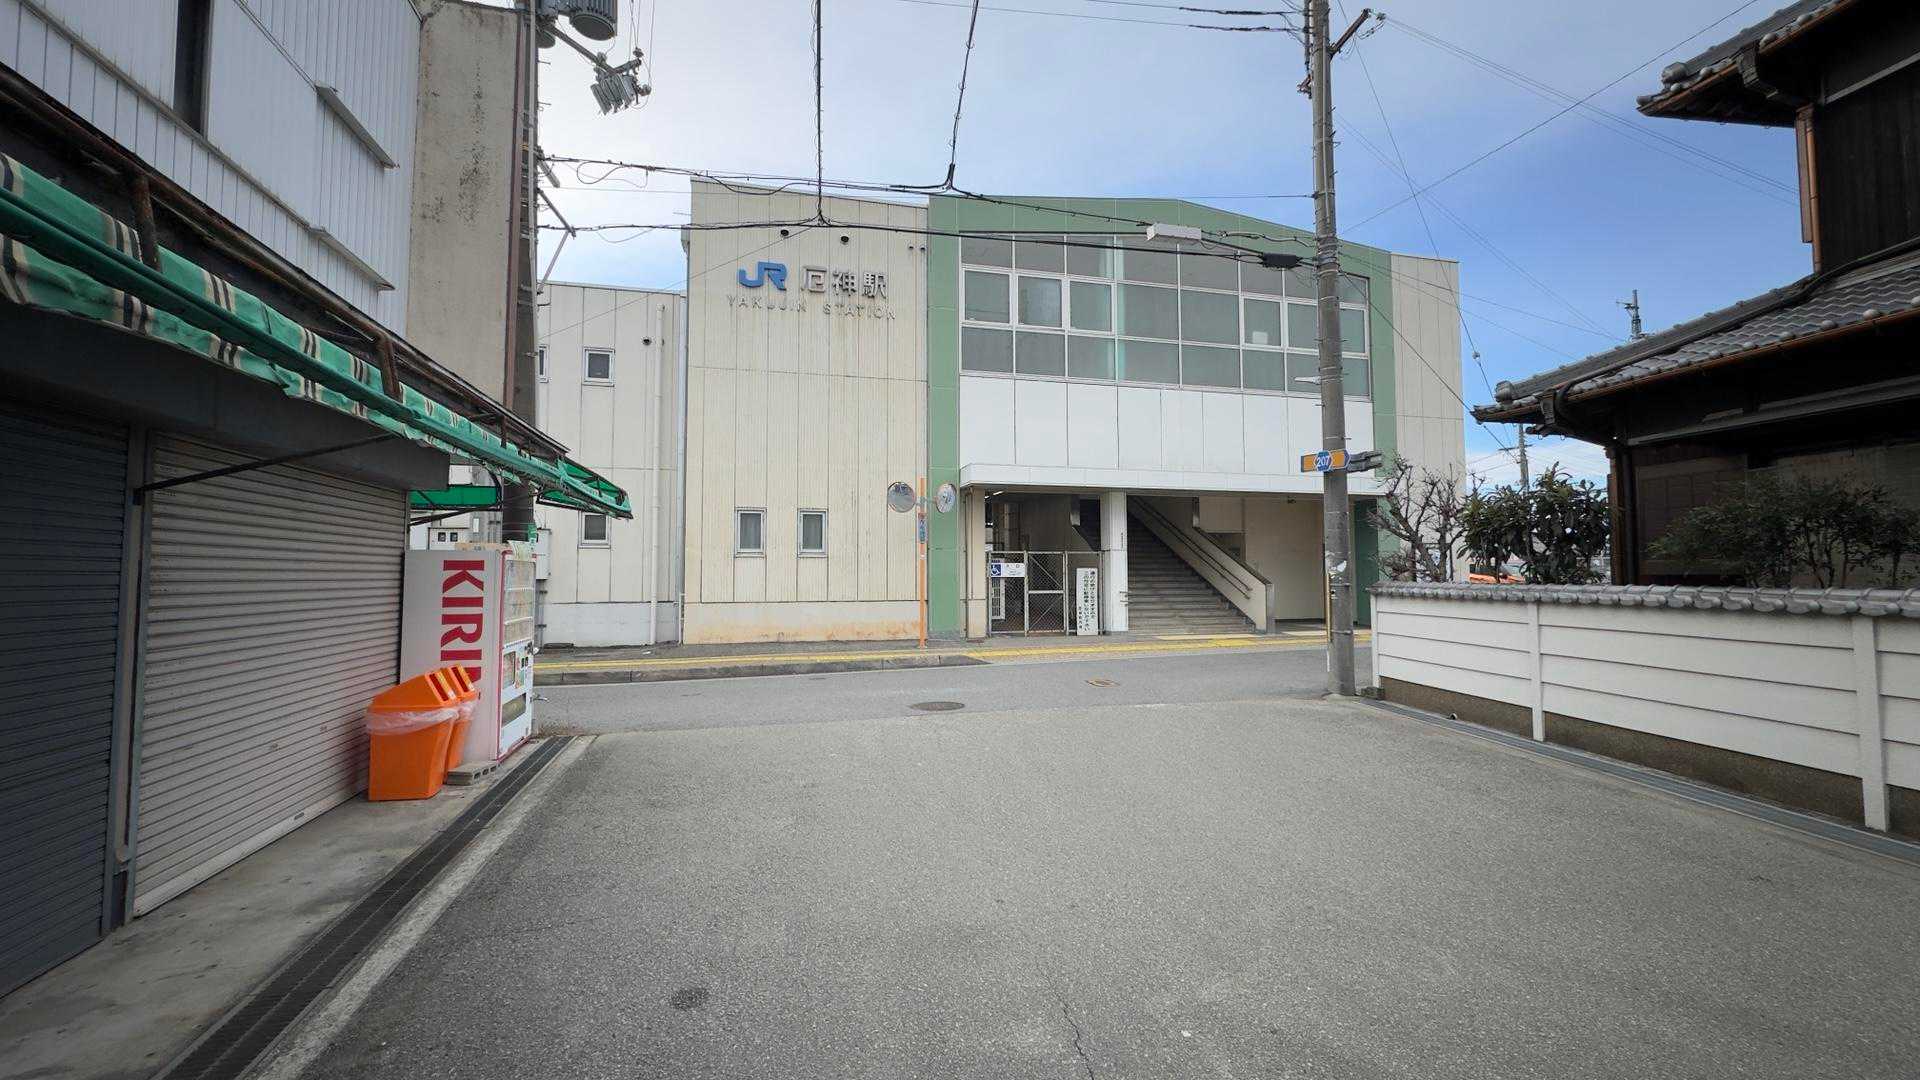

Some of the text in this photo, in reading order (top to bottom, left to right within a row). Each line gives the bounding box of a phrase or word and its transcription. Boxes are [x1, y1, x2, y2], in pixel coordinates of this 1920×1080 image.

[738, 261, 888, 299] JR 厄神駅
[823, 302, 897, 321] STATION
[1317, 455, 1329, 466] 207
[440, 559, 485, 700] KIRI
